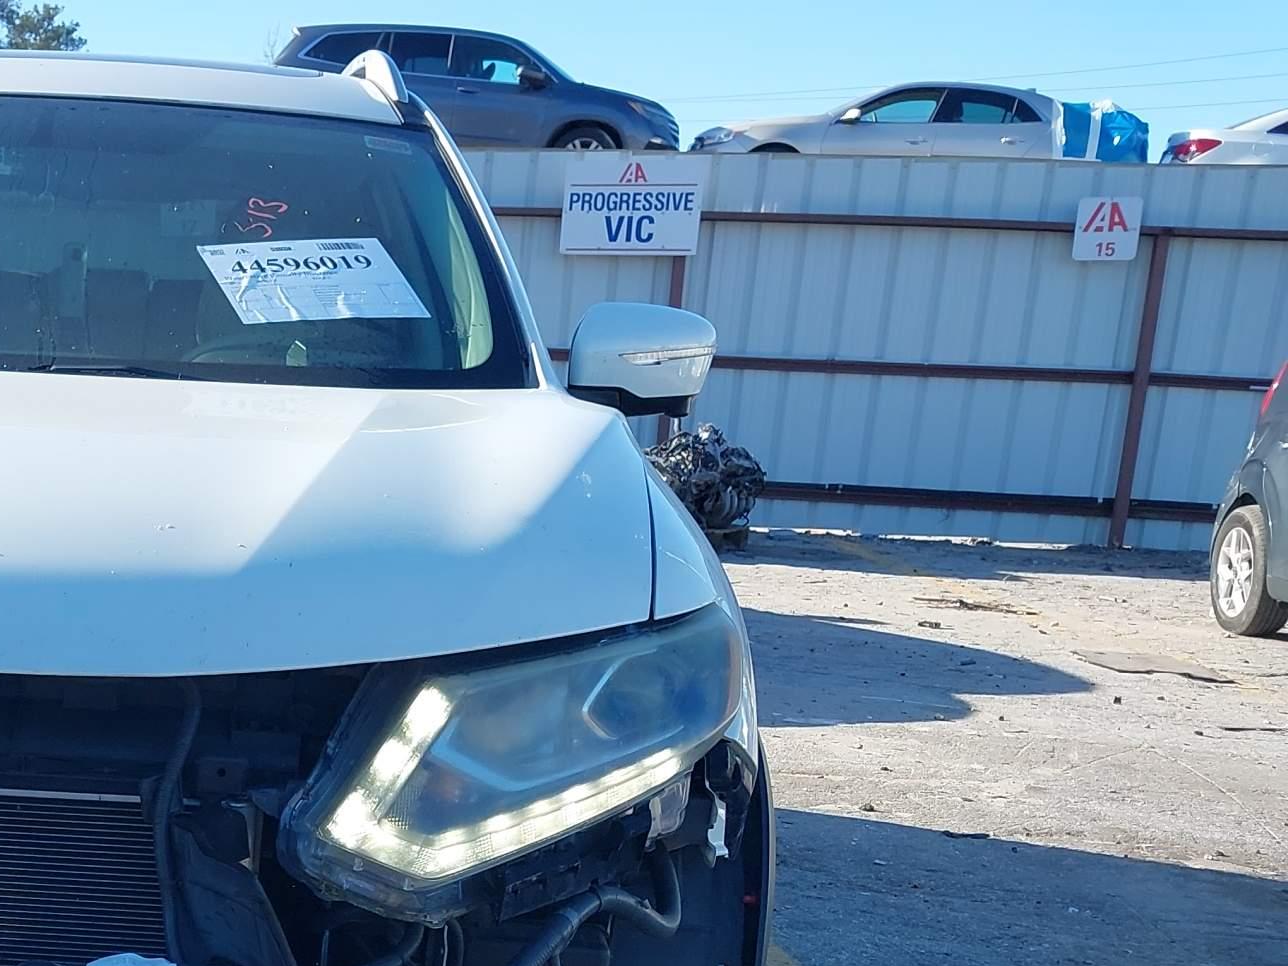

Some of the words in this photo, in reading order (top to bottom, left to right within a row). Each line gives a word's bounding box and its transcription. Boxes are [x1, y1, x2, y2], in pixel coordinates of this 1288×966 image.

[569, 191, 695, 212] PROGRESSIVE
[605, 215, 655, 243] VIC
[1096, 242, 1116, 257] 15
[231, 254, 372, 275] 44596019
